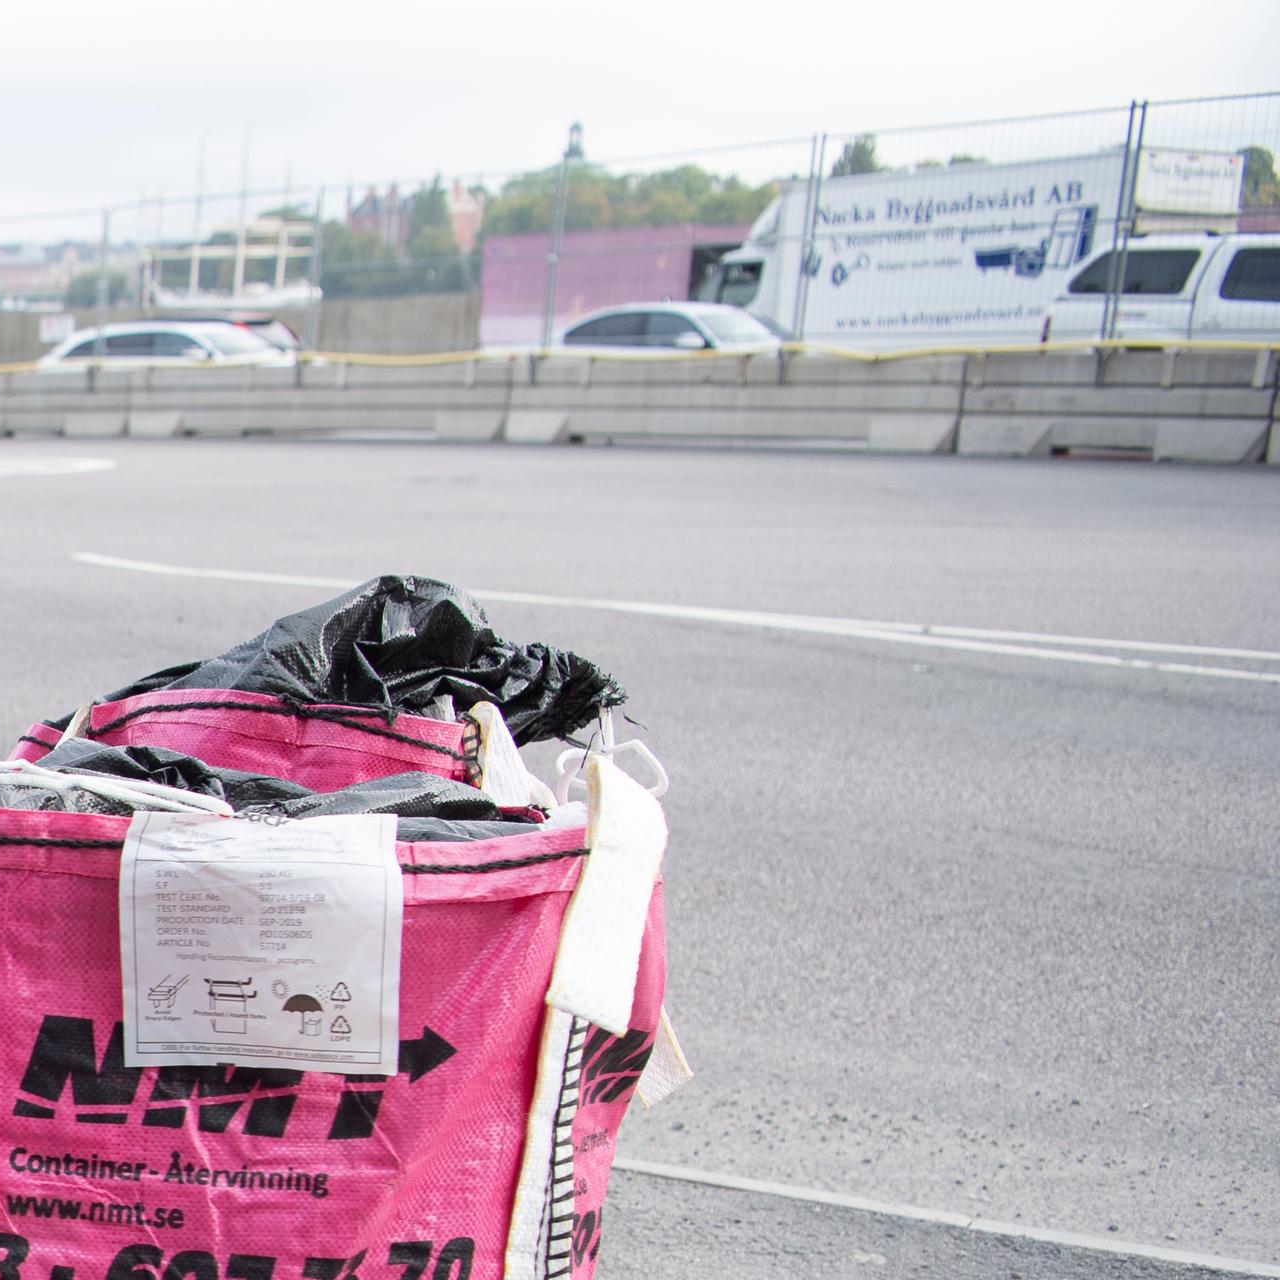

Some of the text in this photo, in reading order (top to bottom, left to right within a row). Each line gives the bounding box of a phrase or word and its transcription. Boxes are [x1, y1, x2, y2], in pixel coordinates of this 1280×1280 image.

[816, 181, 1082, 225] Nacka Byggnadsvård AB
[156, 893, 177, 902] TEST
[156, 905, 231, 914] TEST STANDARD
[156, 916, 244, 926] PRODUCTION DATE
[156, 927, 191, 936] ORDER
[156, 939, 194, 949] ARTICLE
[6, 1191, 186, 1230] www.nmt.se
